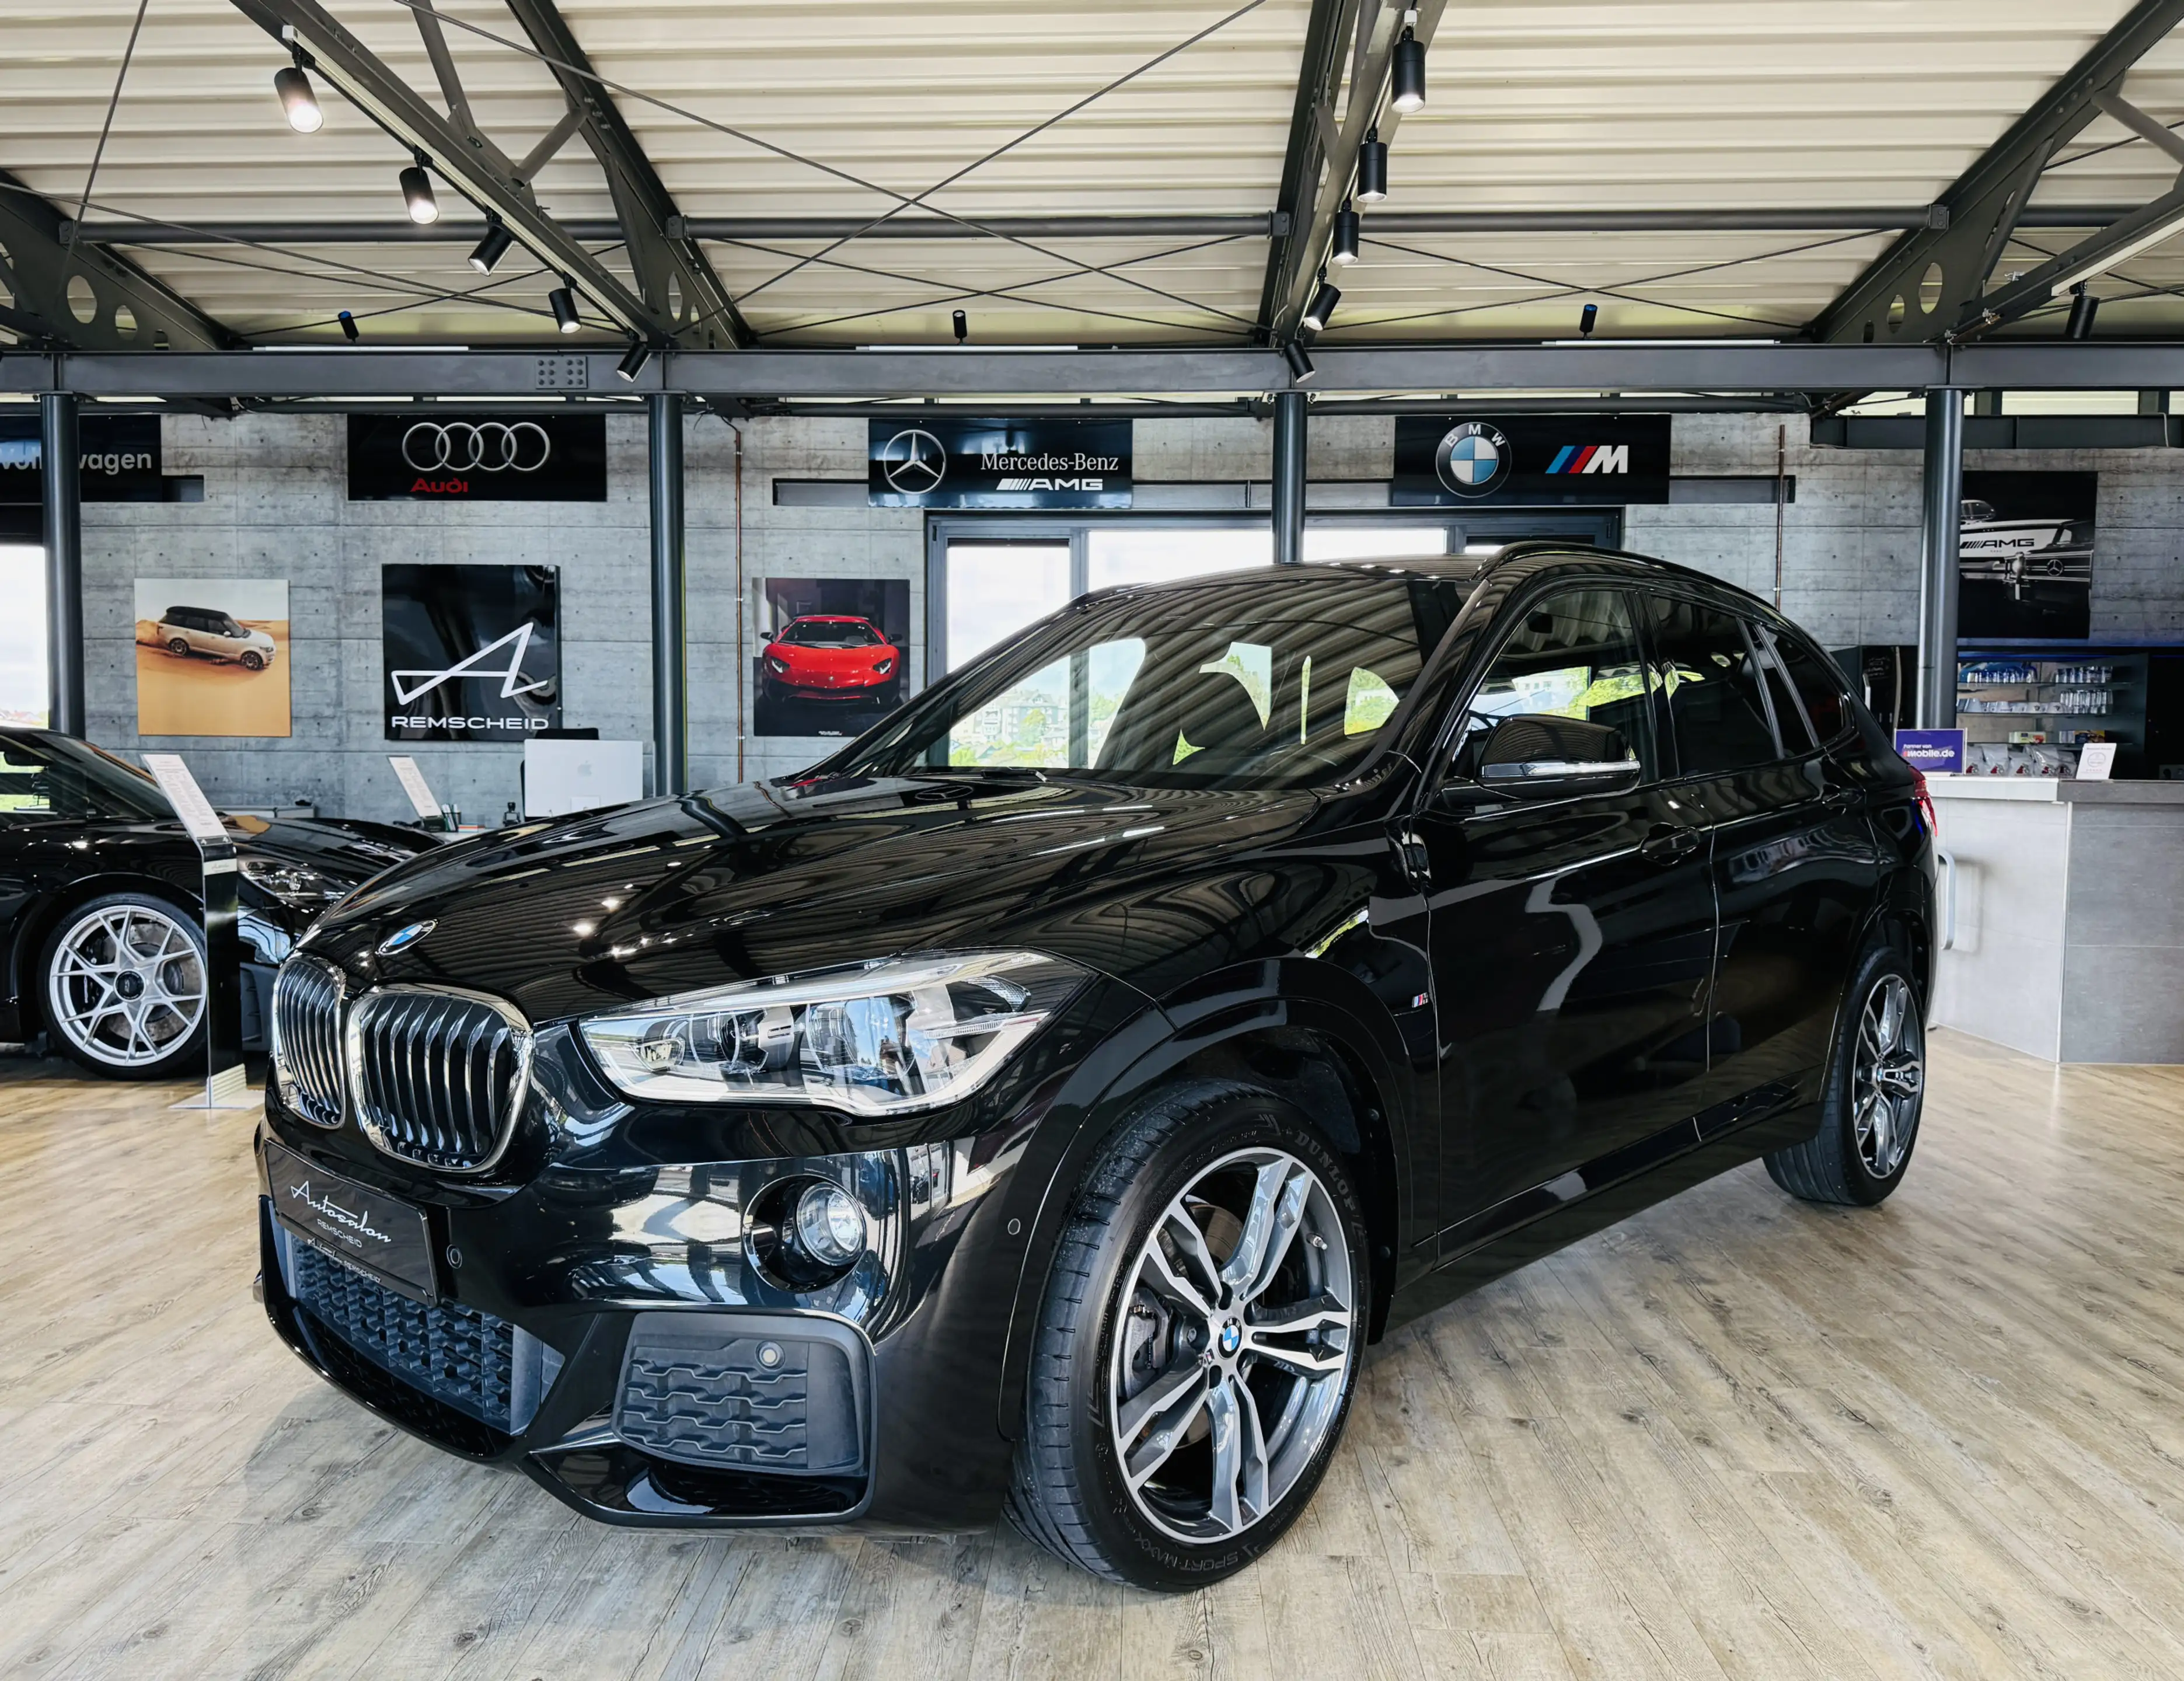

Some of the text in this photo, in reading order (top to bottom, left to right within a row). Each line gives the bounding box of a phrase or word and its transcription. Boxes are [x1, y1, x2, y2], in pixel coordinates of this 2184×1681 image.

[1445, 424, 1505, 447] BMW
[981, 453, 1119, 470] Mercedes-Benz
[410, 477, 469, 493] Audi
[392, 716, 549, 730] REMSCHEID
[1294, 1129, 1356, 1211] DUNLOP
[317, 1218, 362, 1248] REMSCHEID
[1180, 1551, 1239, 1572] SPORT
